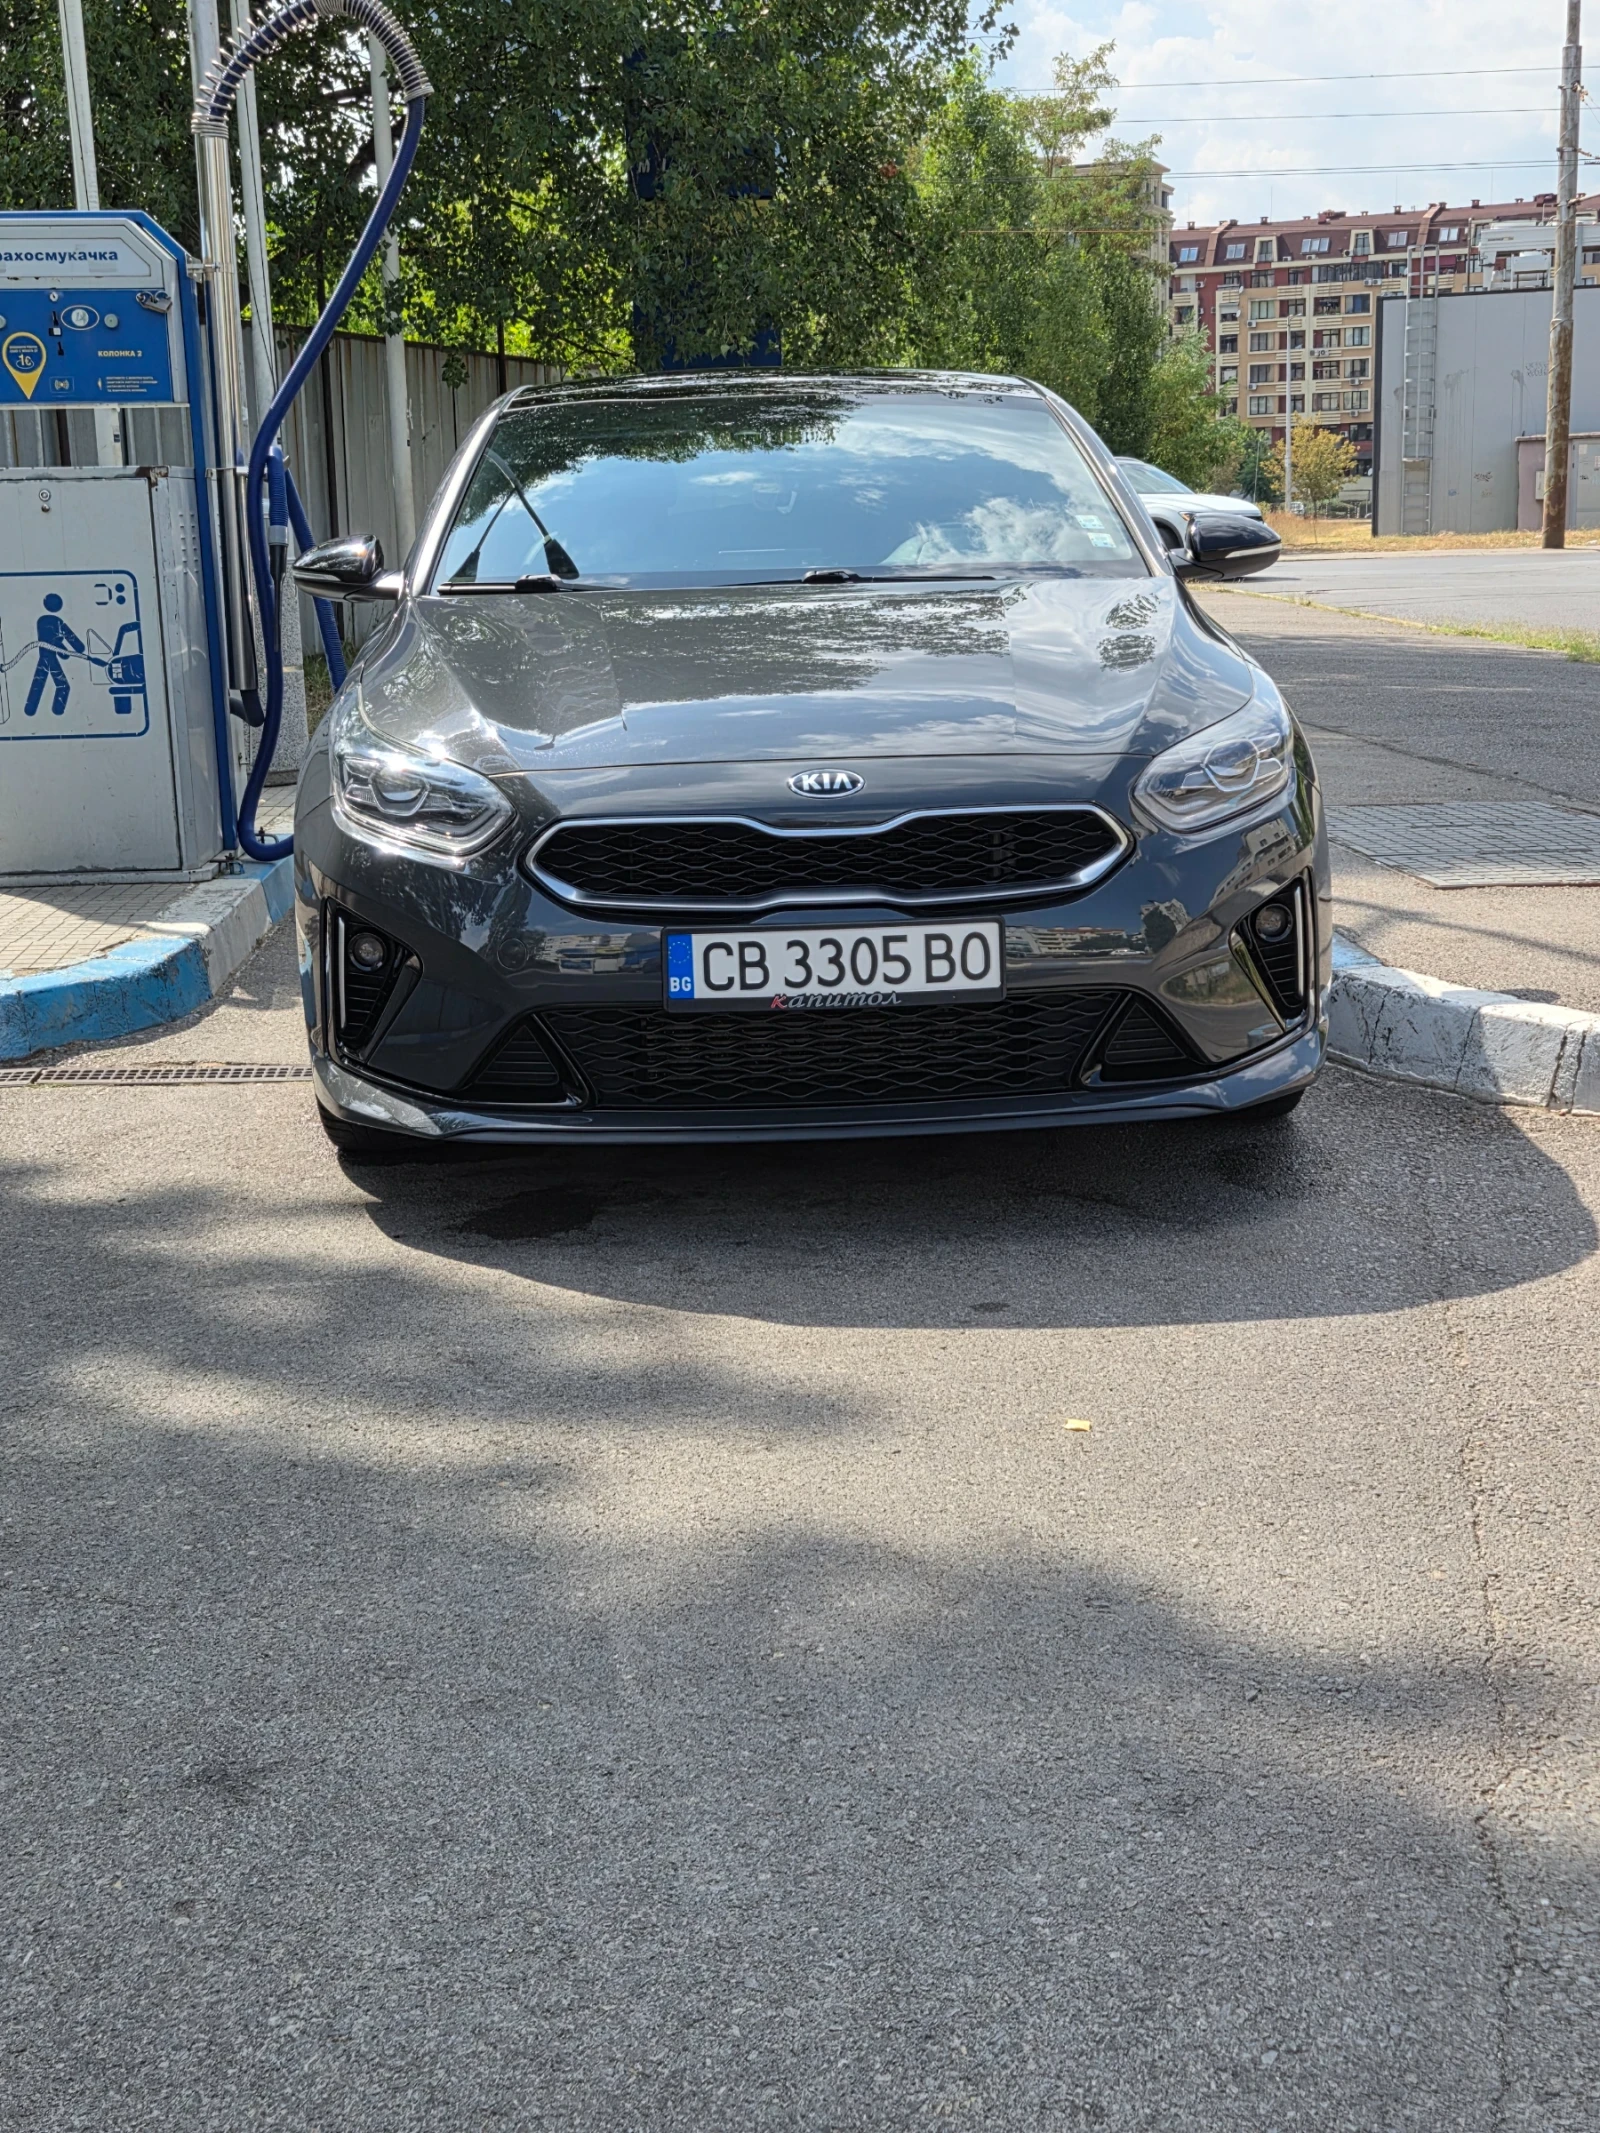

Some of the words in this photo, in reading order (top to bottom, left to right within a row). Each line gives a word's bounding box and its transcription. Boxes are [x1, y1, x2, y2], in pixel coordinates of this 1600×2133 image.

[0, 250, 118, 264] ахосмукачка
[801, 773, 853, 791] KIA
[784, 934, 912, 989] 3305
[669, 976, 692, 992] BG
